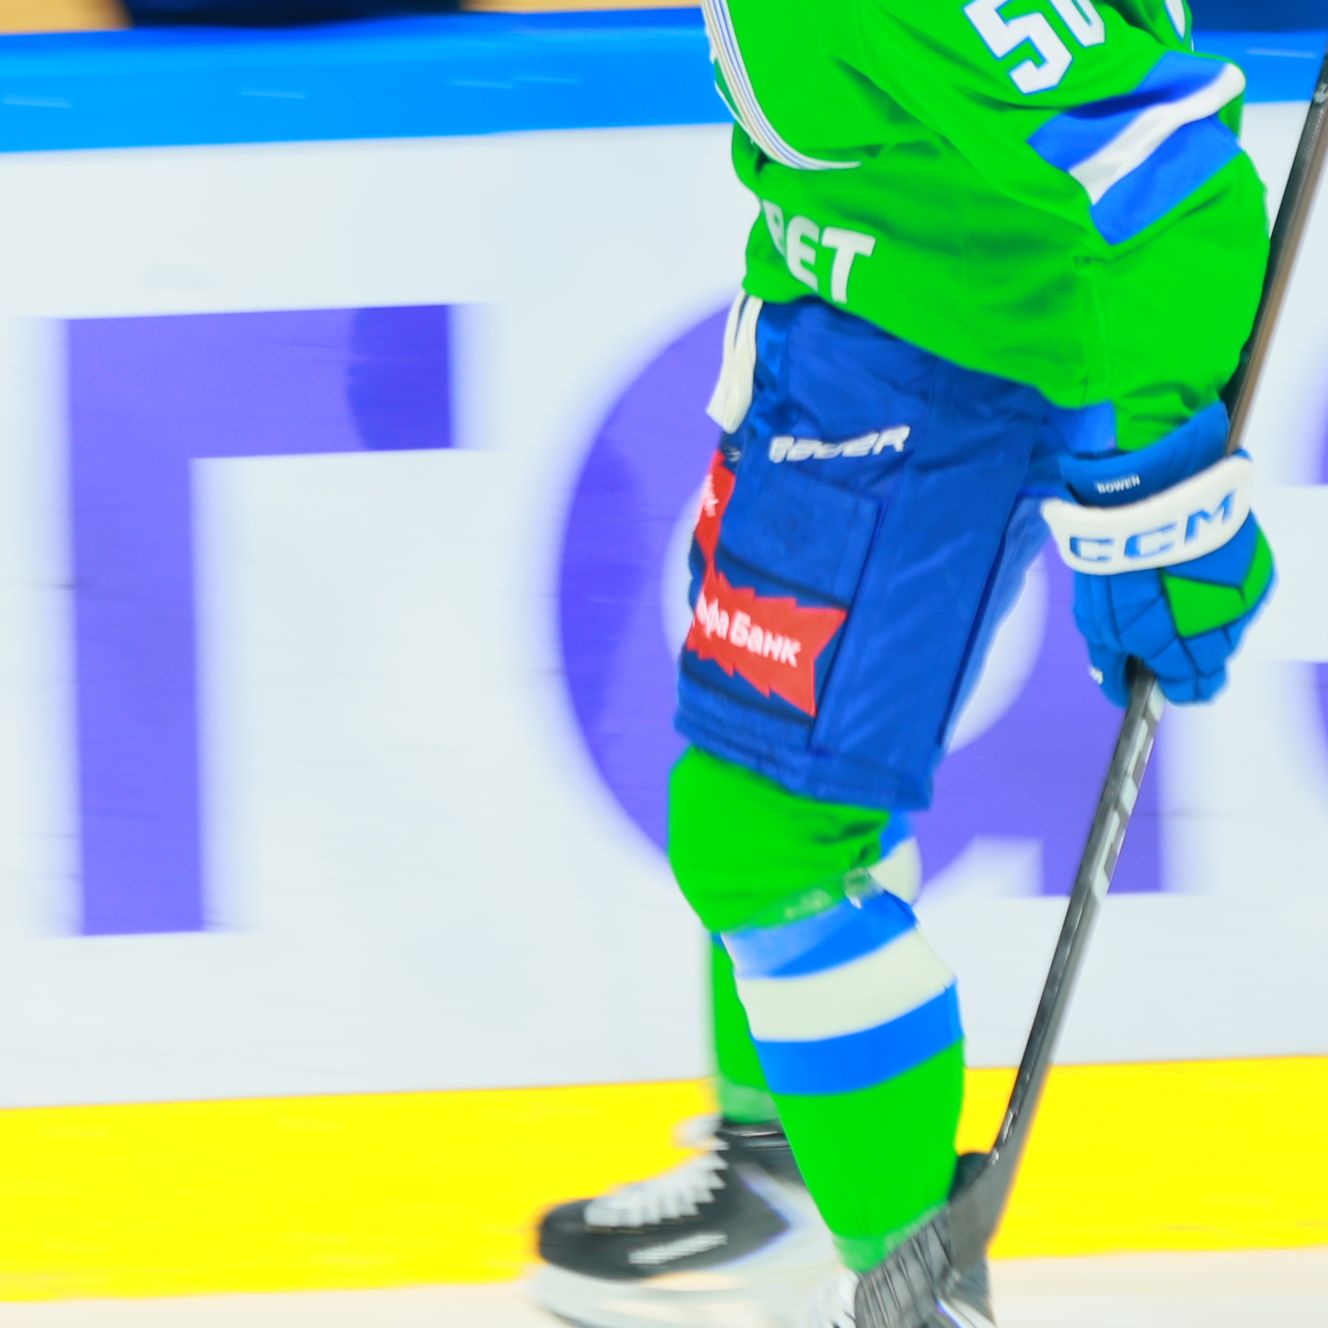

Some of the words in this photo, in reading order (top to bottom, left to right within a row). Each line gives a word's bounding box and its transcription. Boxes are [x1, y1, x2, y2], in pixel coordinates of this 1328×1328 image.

[1095, 475, 1141, 495] BOWEN
[1069, 490, 1236, 563] CCM
[730, 610, 801, 668] Банк
